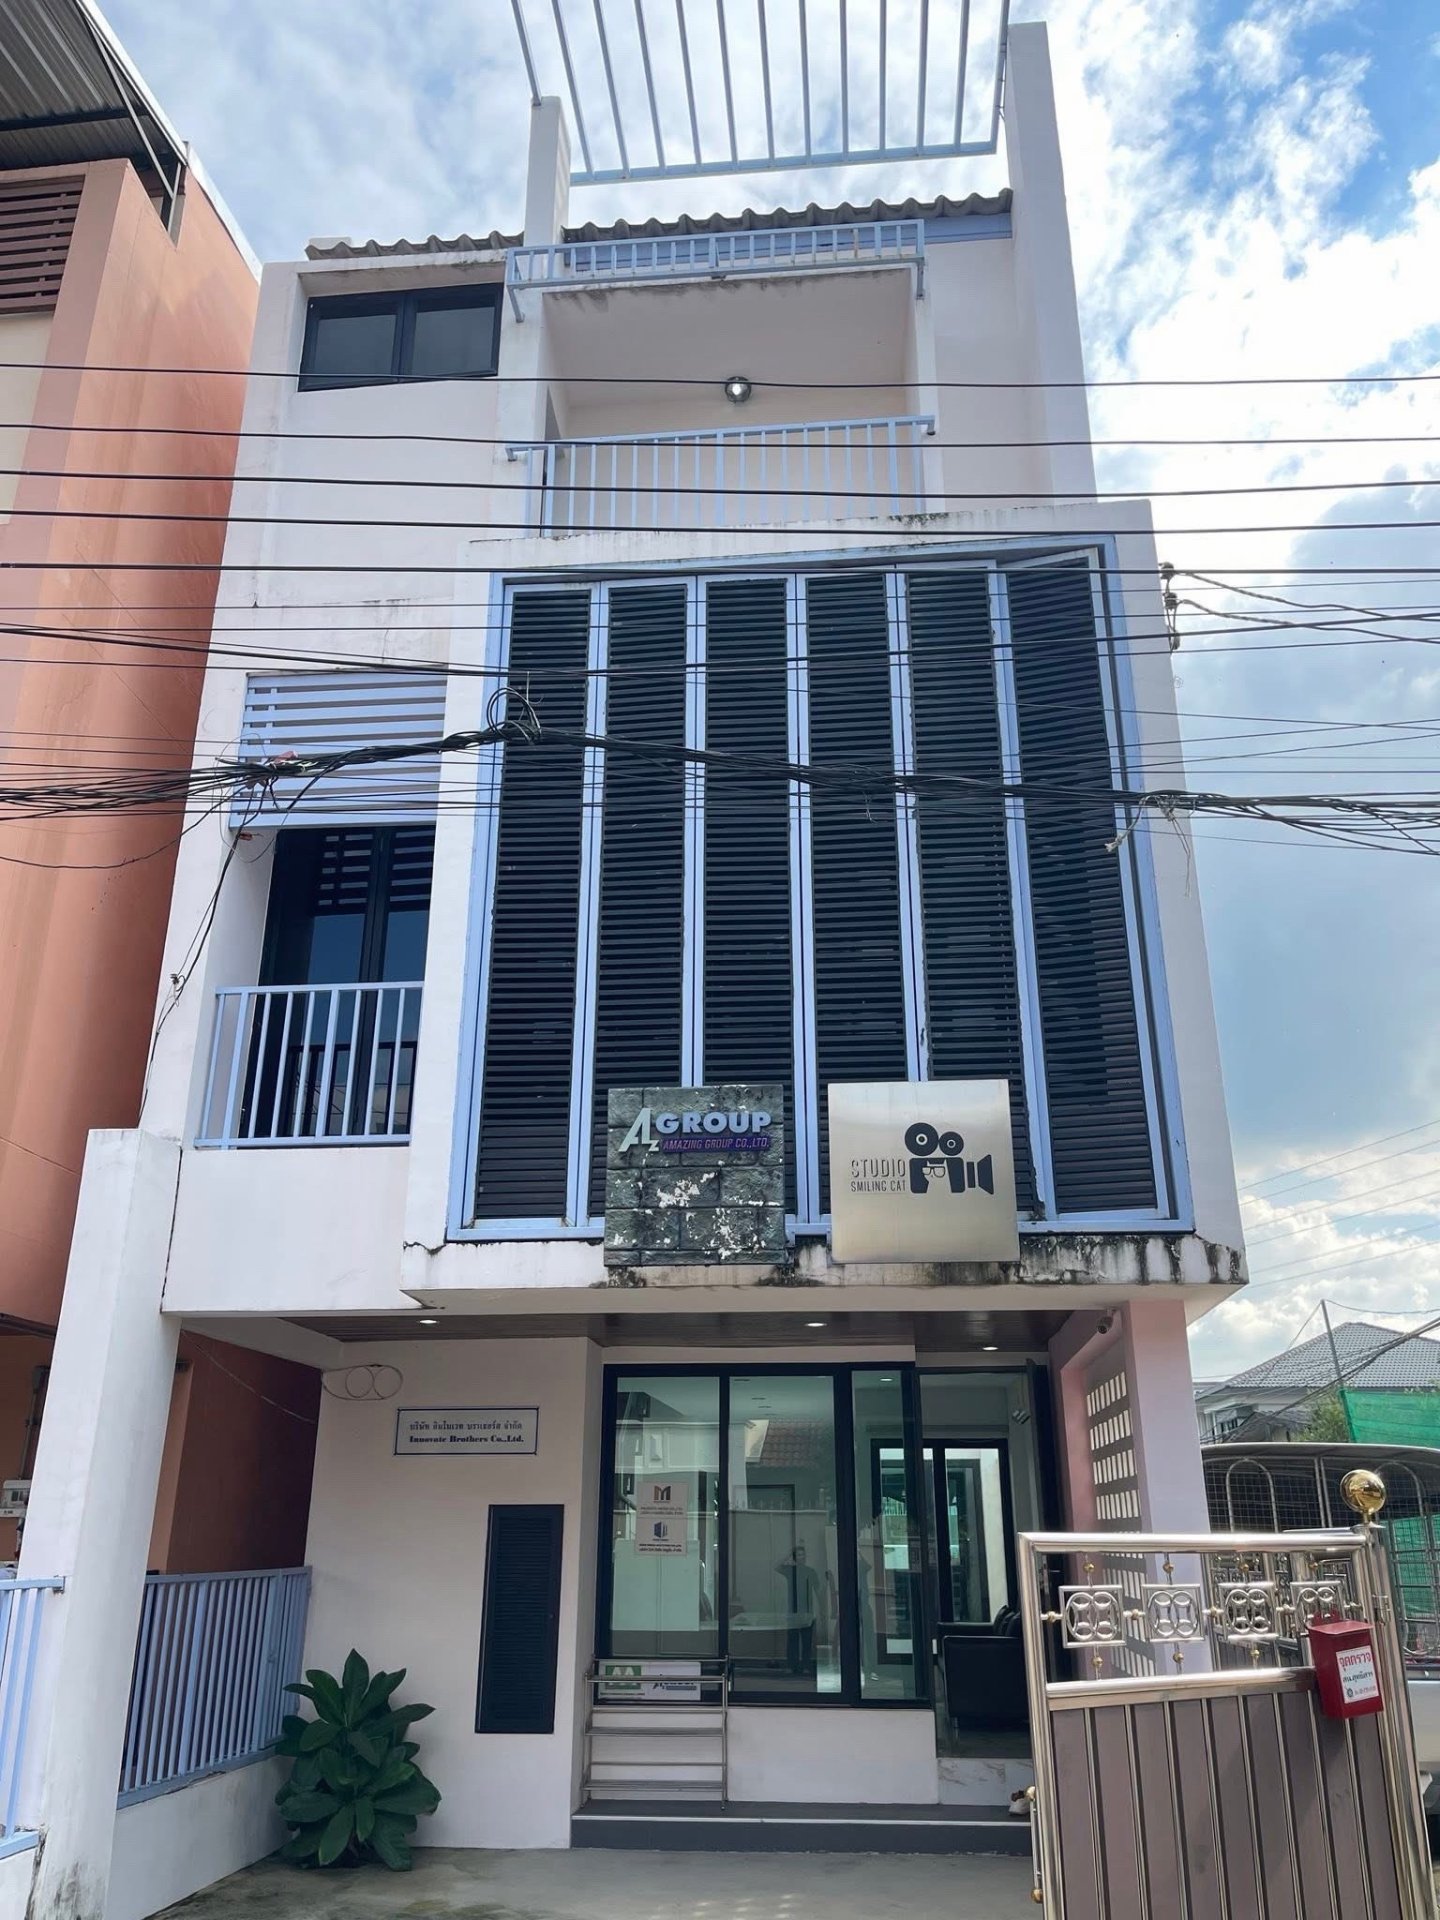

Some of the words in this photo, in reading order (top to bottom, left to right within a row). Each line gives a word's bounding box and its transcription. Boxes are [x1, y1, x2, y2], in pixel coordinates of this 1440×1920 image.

[655, 1111, 771, 1134] GROUP
[663, 1138, 702, 1149] AMAZING
[705, 1138, 732, 1149] GROUP
[735, 1137, 769, 1148] CO.,LTD.
[851, 1158, 906, 1178] STUDIO
[851, 1181, 887, 1192] SMILING
[890, 1180, 906, 1191] CAT
[410, 1421, 430, 1431] บริษัท
[504, 1420, 522, 1431] จำกัด
[410, 1435, 447, 1443] Innovate
[450, 1435, 489, 1443] Brothers
